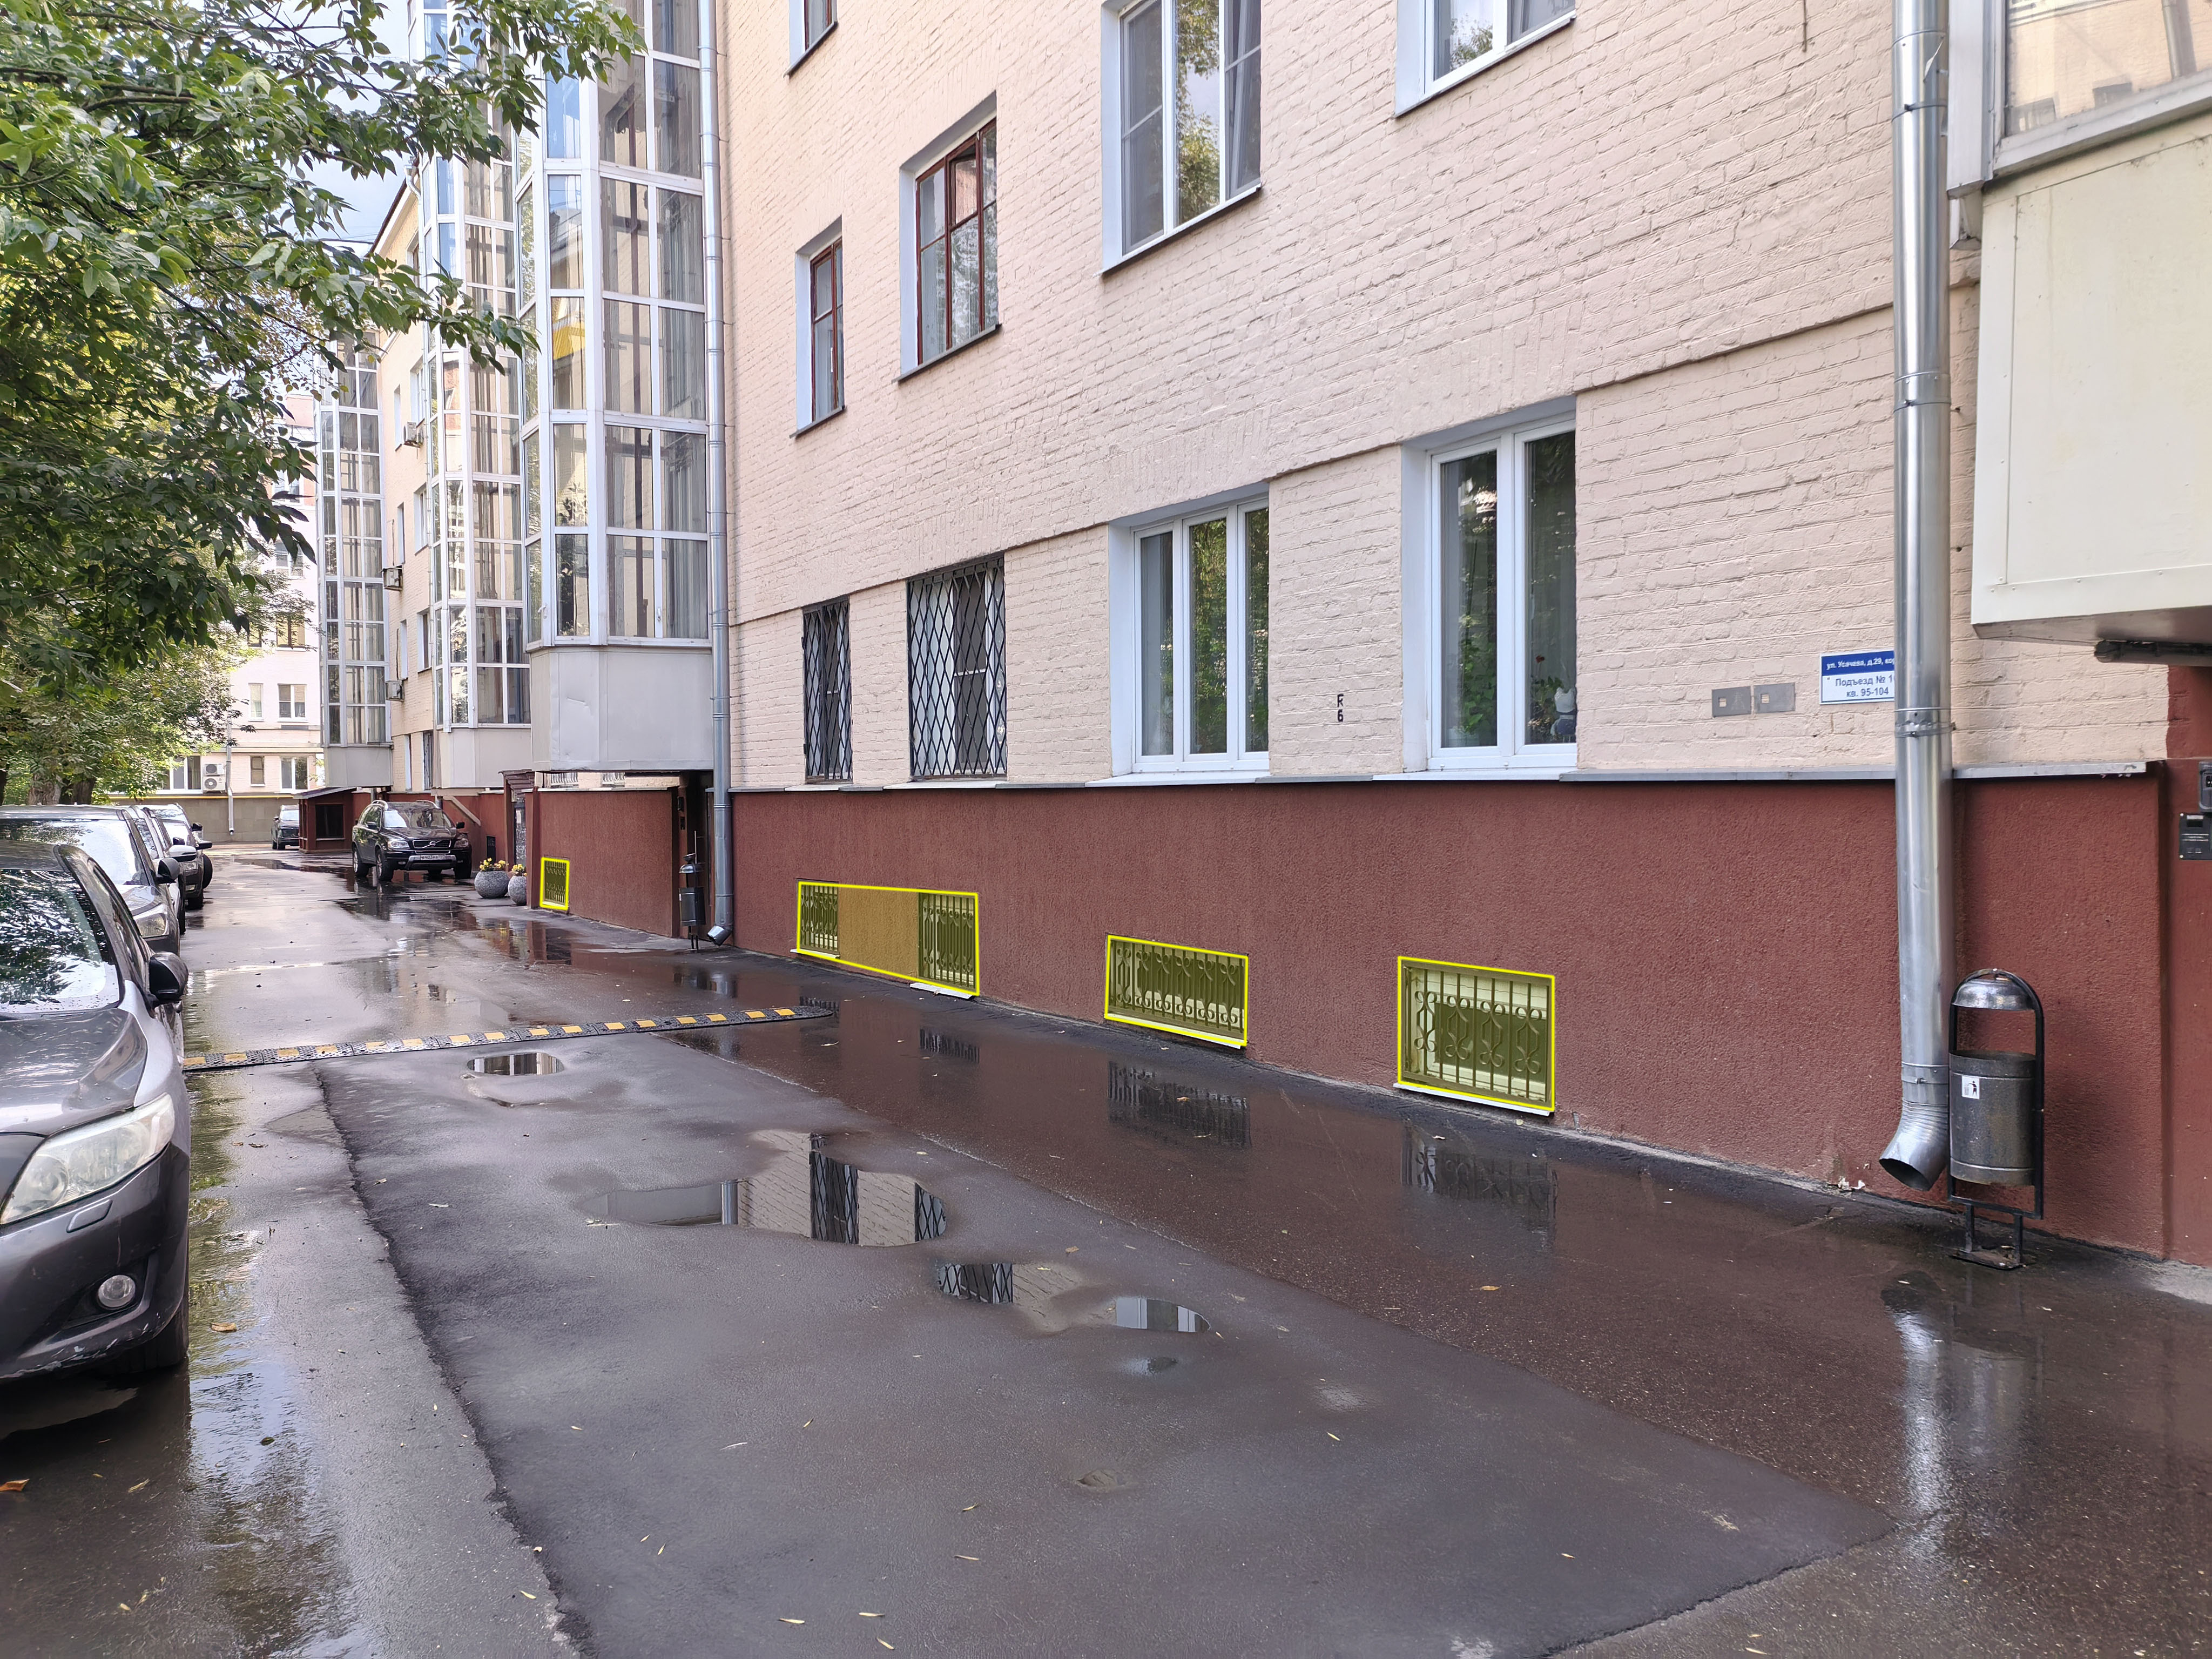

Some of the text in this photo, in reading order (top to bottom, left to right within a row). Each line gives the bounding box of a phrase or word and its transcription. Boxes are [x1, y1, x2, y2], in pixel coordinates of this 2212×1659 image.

[1836, 678, 1873, 687] Подъезд
[1876, 675, 1886, 684] №
[1860, 686, 1889, 697] 95-104
